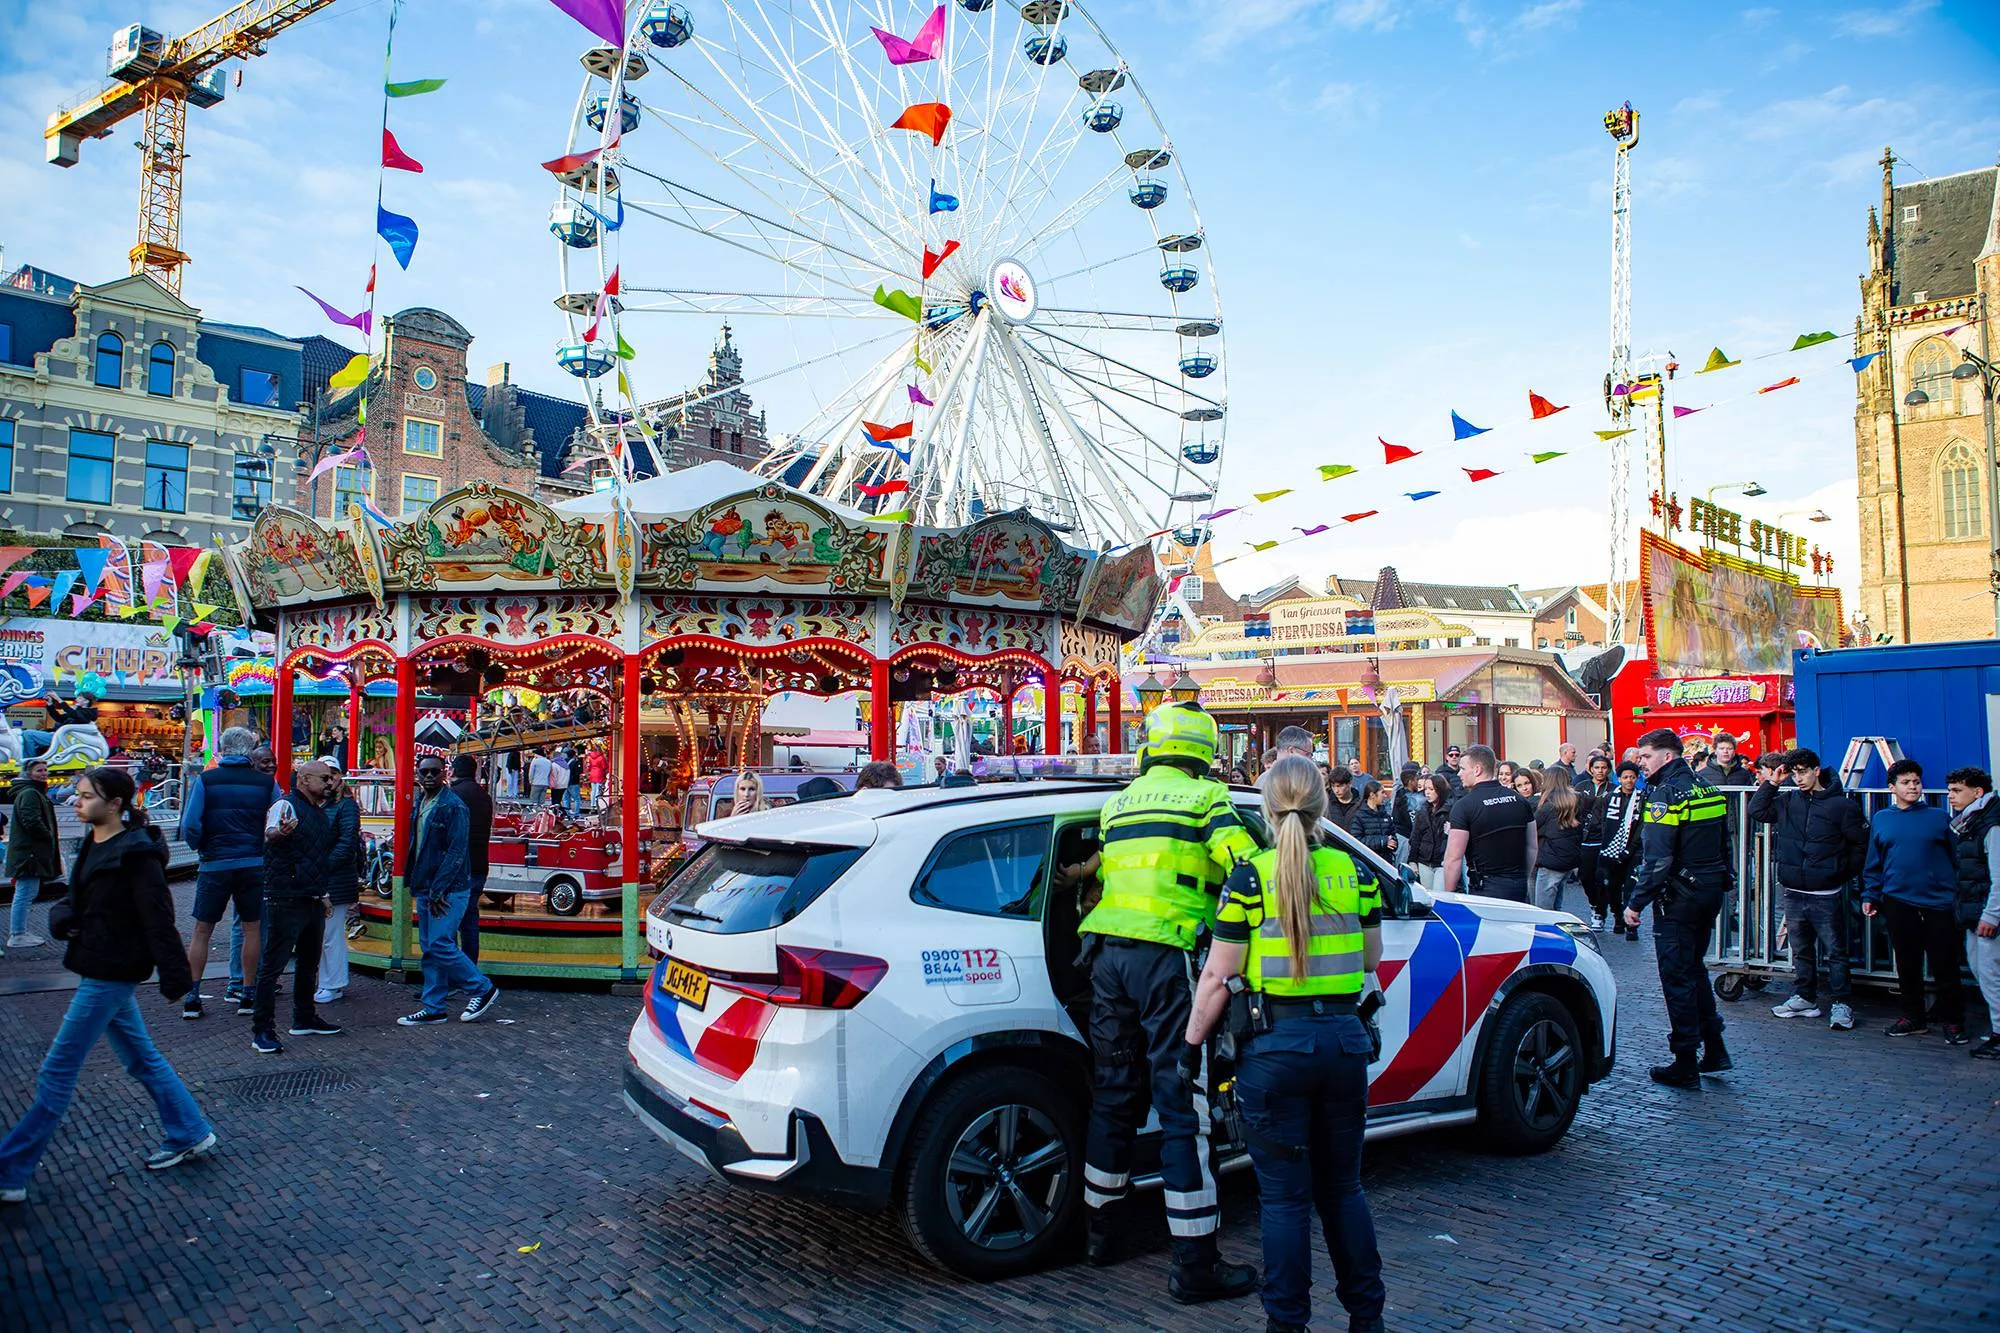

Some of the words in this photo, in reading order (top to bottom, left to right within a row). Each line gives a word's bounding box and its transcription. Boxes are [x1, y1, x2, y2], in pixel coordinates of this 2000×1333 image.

[1689, 496, 1741, 546] FREE
[1749, 518, 1808, 567] STYLE
[1281, 608, 1298, 619] Van
[1257, 621, 1347, 642] FFERTJESSA
[1564, 631, 1584, 641] HOTEL
[1482, 795, 1517, 806] SECURITY
[1266, 875, 1357, 894] PTIE
[921, 950, 960, 961] 0900
[961, 948, 1000, 968] 112
[923, 962, 962, 975] 8844
[965, 970, 1002, 984] spoed
